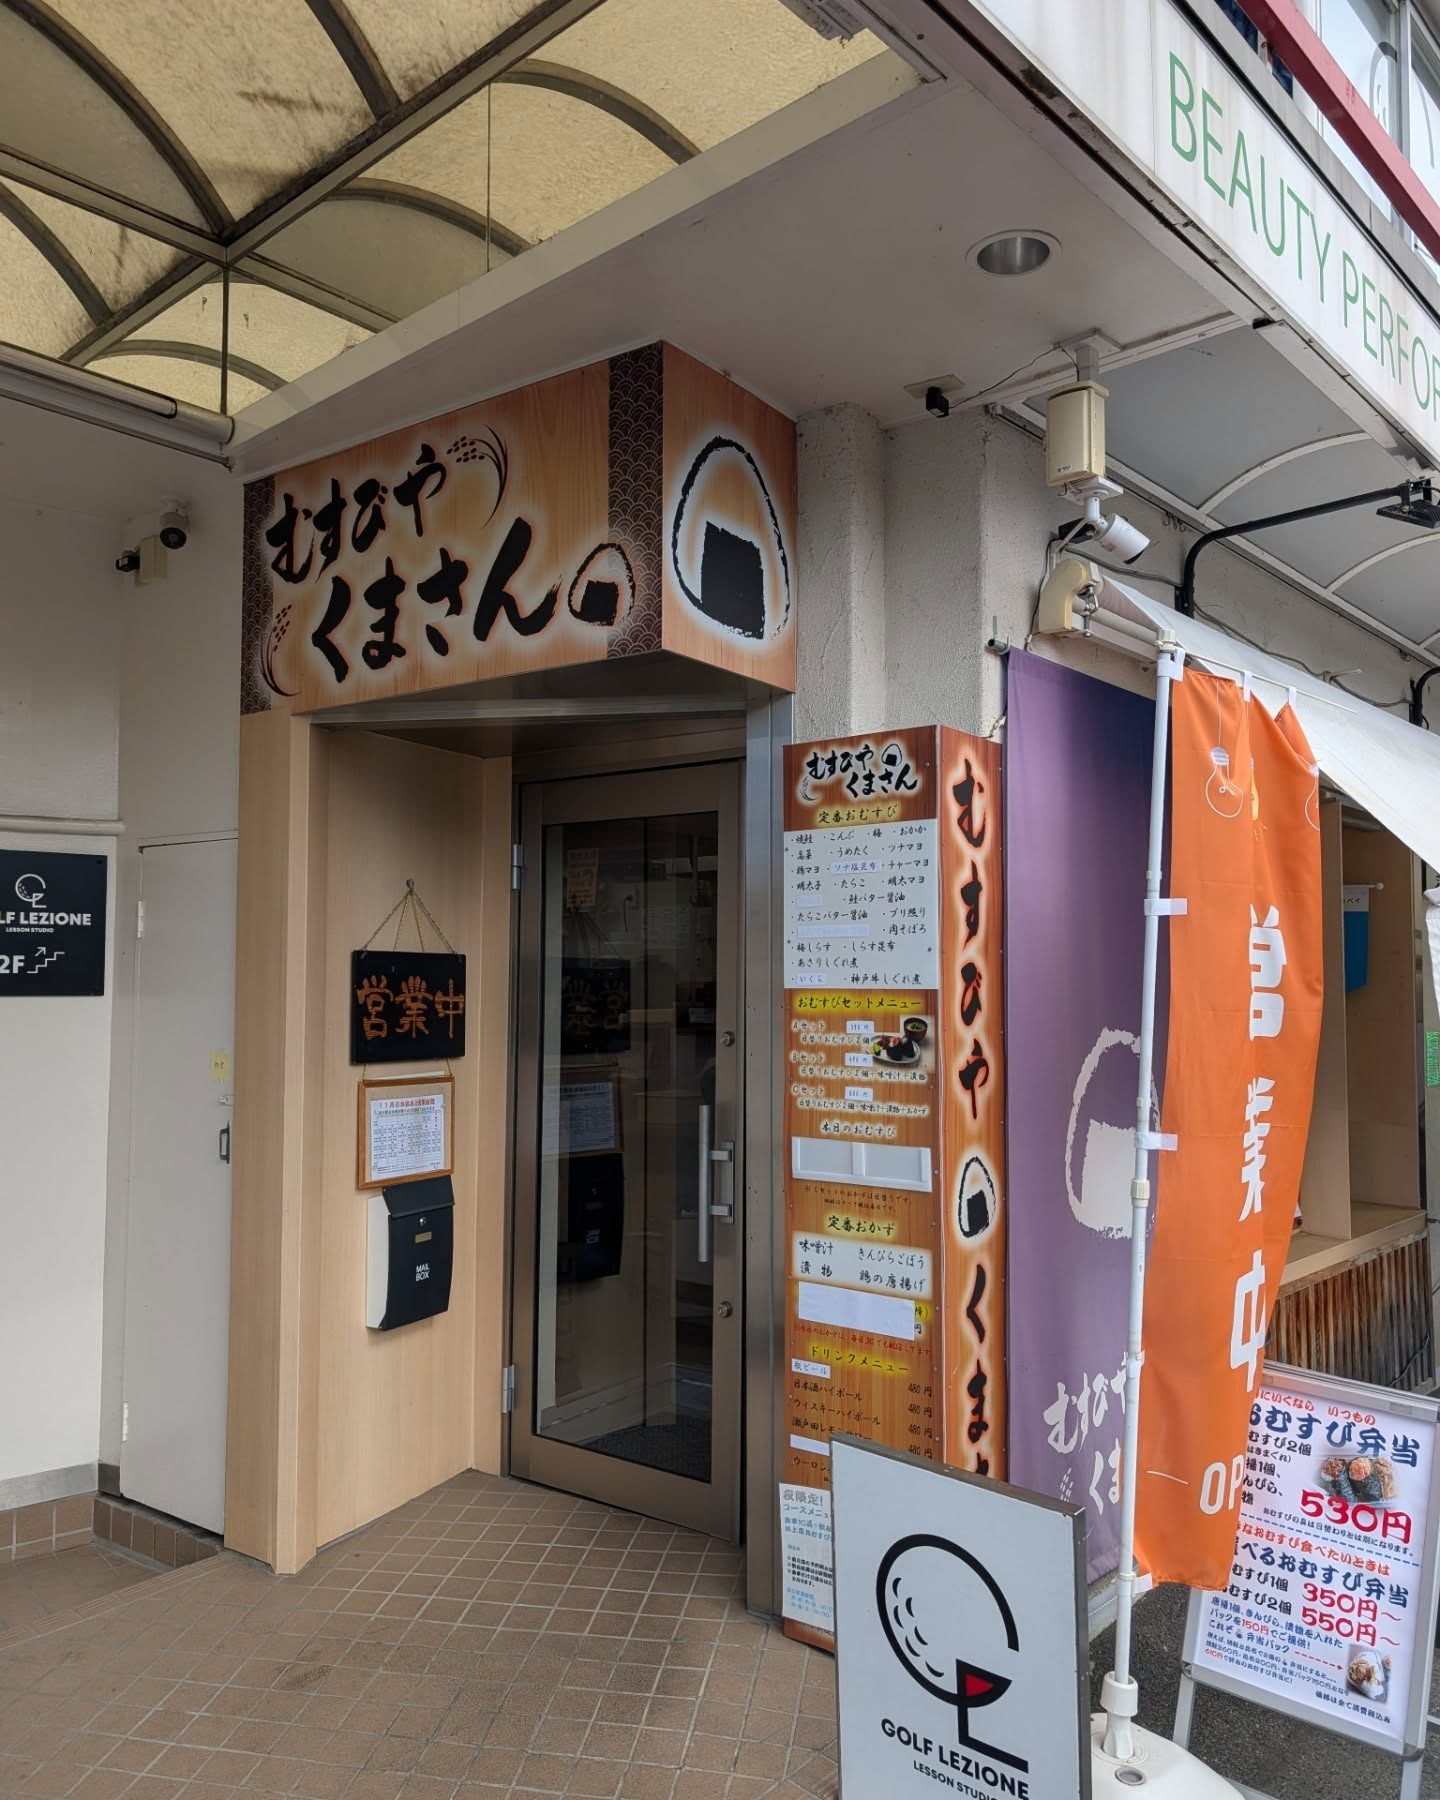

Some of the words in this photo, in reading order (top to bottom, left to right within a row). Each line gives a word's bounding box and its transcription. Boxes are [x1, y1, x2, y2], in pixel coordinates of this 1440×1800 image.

[1169, 50, 1332, 304] BEAUTY
[266, 443, 447, 584] むすびや
[311, 516, 562, 683] くまさん
[806, 744, 874, 781] むすびや
[846, 763, 919, 798] くまさん
[818, 803, 898, 824] 定番おむすび
[900, 825, 927, 836] おかか
[838, 845, 869, 857] うめたく
[888, 842, 923, 852] ツナマヨ
[841, 878, 866, 889] たらこ
[888, 875, 925, 887] 明太マヨ
[20, 911, 92, 926] LEZIONE
[952, 757, 990, 1121] むすびや
[0, 954, 25, 974] 2F
[357, 975, 464, 1040] 営業中
[798, 996, 922, 1009] おむすびセットメニュー
[822, 1121, 896, 1137] 本日のおむすび
[827, 1215, 896, 1237] 定番おかず
[798, 1238, 835, 1255] 味噌汁
[416, 1271, 430, 1281] BOX
[810, 1345, 909, 1372] ドリンクメニュー
[794, 1379, 863, 1401] 日本酒ハイボール
[1327, 1405, 1377, 1427] いつもの
[793, 1456, 831, 1473] ウーロン
[1300, 1489, 1413, 1545] 530円
[1222, 1583, 1292, 1616] むすび2個
[1208, 1619, 1234, 1636] これぞ
[881, 1718, 933, 1756] GOLF
[938, 1745, 1030, 1800] LEZIONE
[913, 1760, 954, 1788] LESSON
